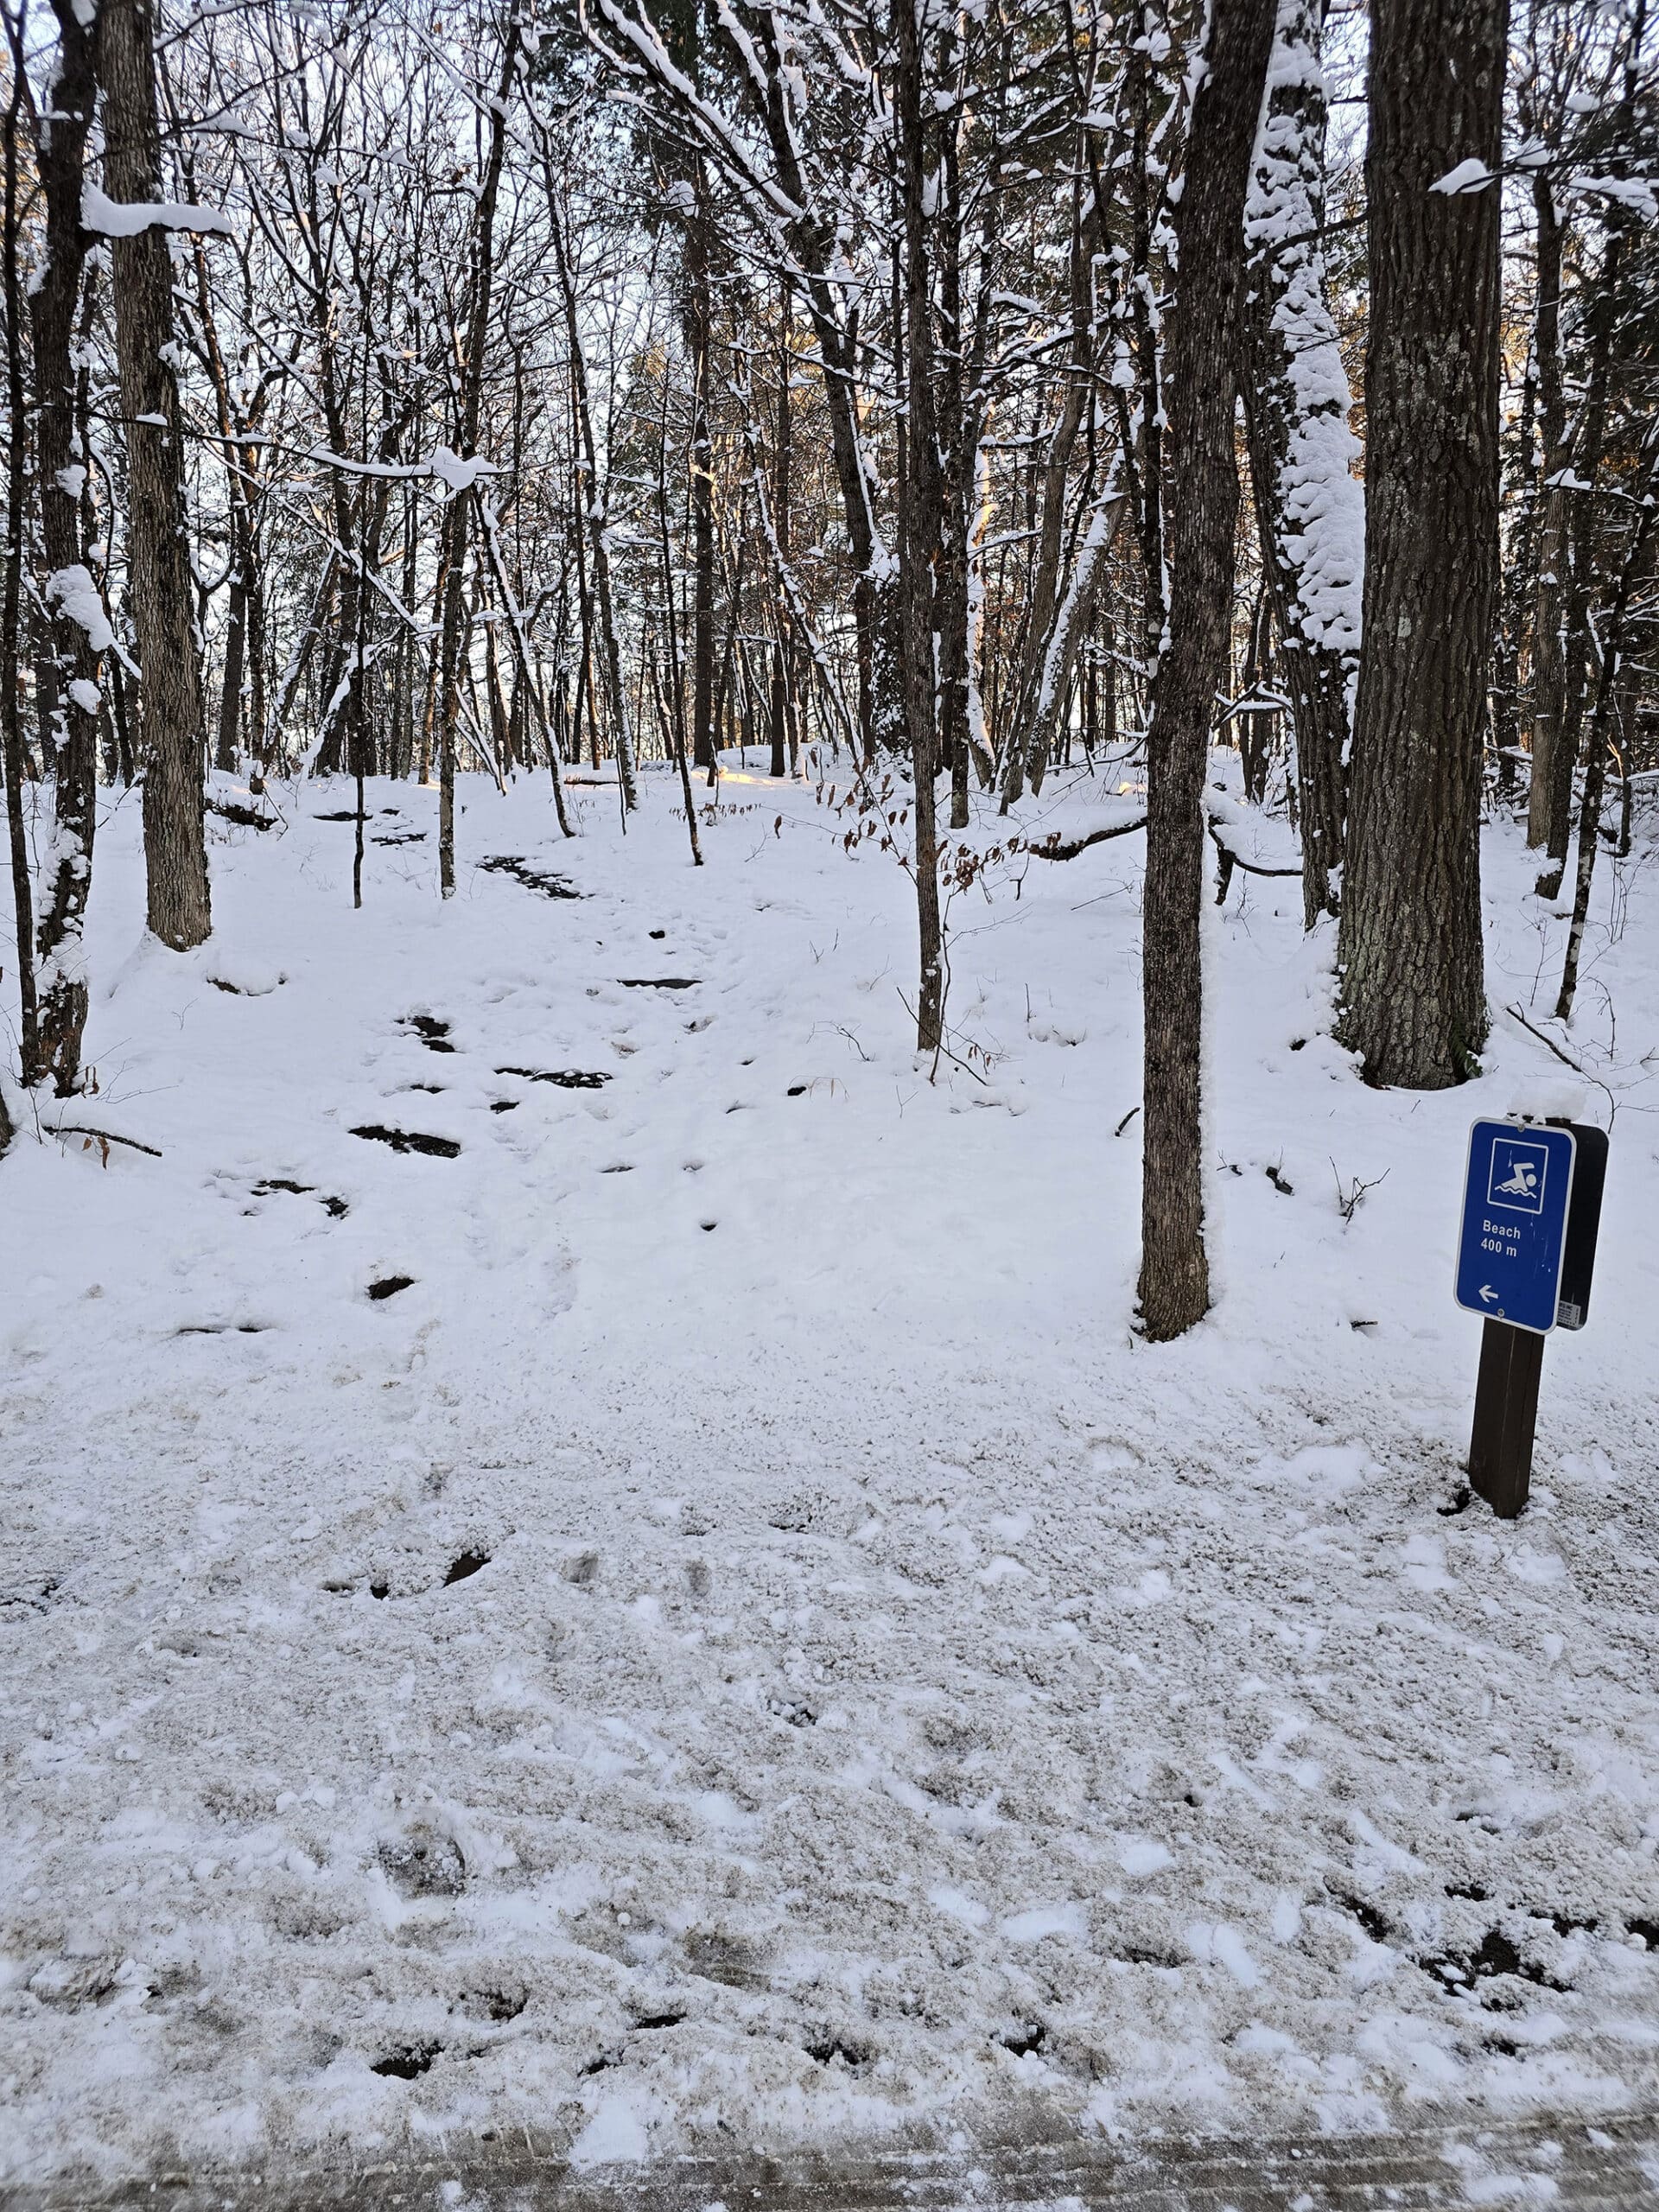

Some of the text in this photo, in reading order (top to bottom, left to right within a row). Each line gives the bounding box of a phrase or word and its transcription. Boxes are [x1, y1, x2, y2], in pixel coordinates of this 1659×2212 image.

[1483, 1219, 1521, 1240] Beach
[1480, 1237, 1517, 1257] 400 m
